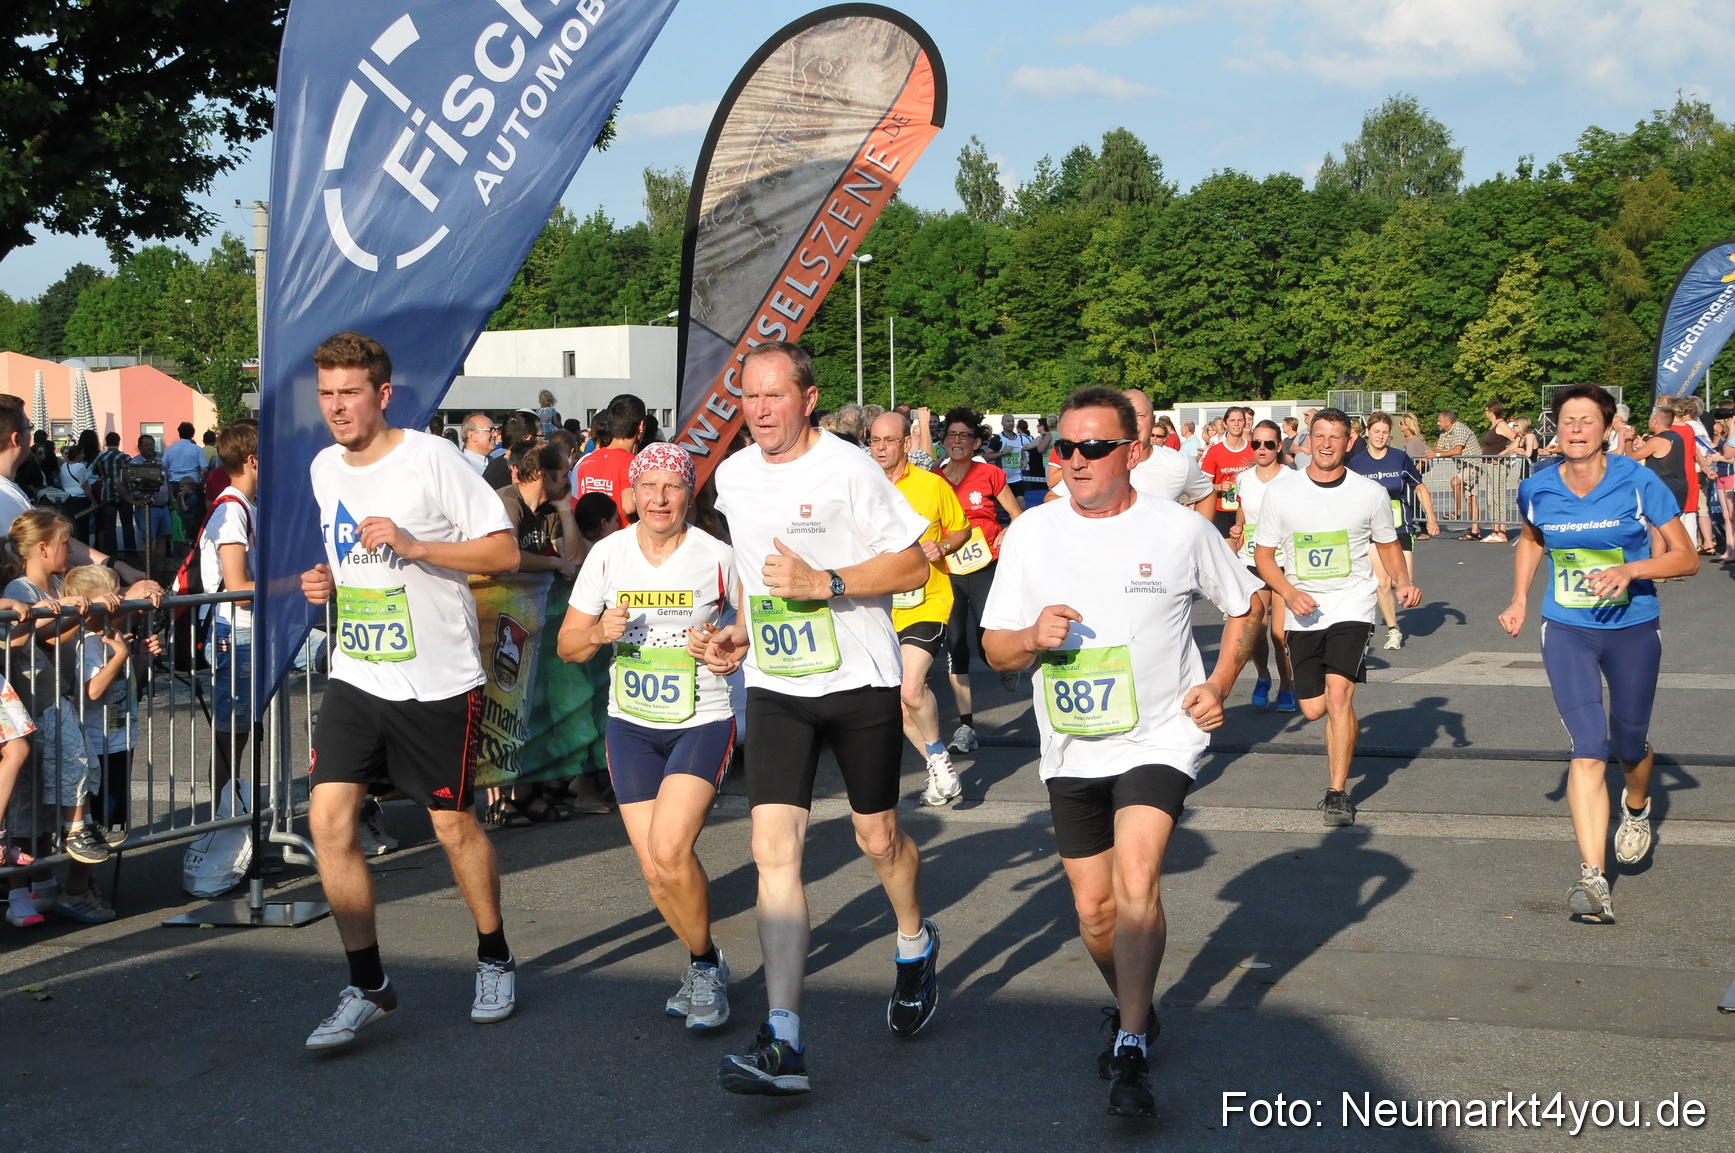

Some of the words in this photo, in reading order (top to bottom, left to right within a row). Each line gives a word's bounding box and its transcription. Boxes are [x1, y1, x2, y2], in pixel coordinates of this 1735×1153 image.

[473, 0, 614, 207] AUTOMOB
[678, 113, 912, 458] WECSELSZENE.DE
[1006, 457, 1019, 465] 515
[786, 526, 827, 534] Lammsbräu
[344, 551, 382, 564] Team
[952, 542, 983, 565] 145
[1308, 548, 1333, 567] 67
[620, 593, 686, 605] ONLINE
[1124, 586, 1167, 594] Lammsbräu
[657, 608, 693, 617] Germany
[341, 622, 408, 651] 5073
[761, 621, 817, 656] 901
[624, 670, 680, 703] 905
[1054, 677, 1116, 714] 887
[185, 853, 204, 865] ER
